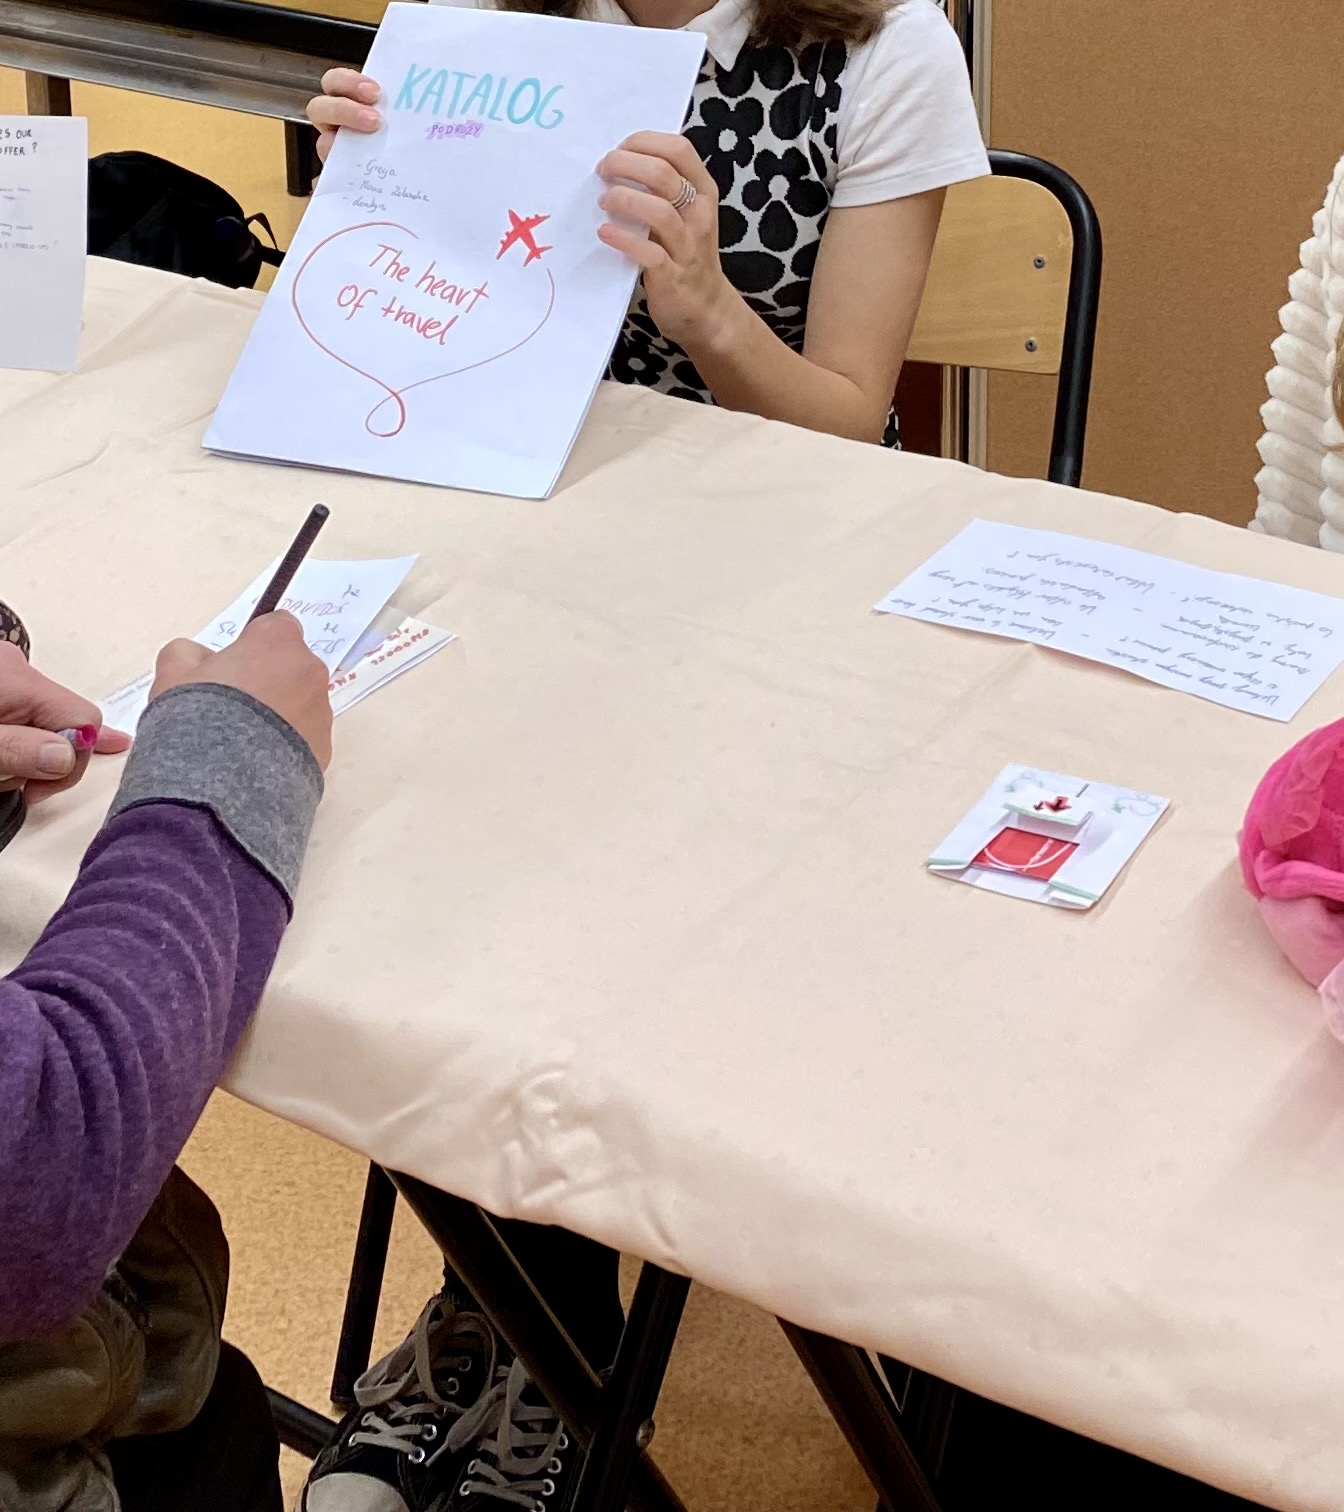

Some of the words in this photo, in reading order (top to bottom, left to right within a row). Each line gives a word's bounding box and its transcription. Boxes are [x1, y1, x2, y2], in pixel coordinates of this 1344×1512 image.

[393, 63, 565, 129] KATALOG
[16, 129, 33, 139] OUR
[369, 243, 410, 282] The
[415, 260, 490, 314] heart
[336, 285, 378, 321] Of
[381, 296, 459, 345] travel
